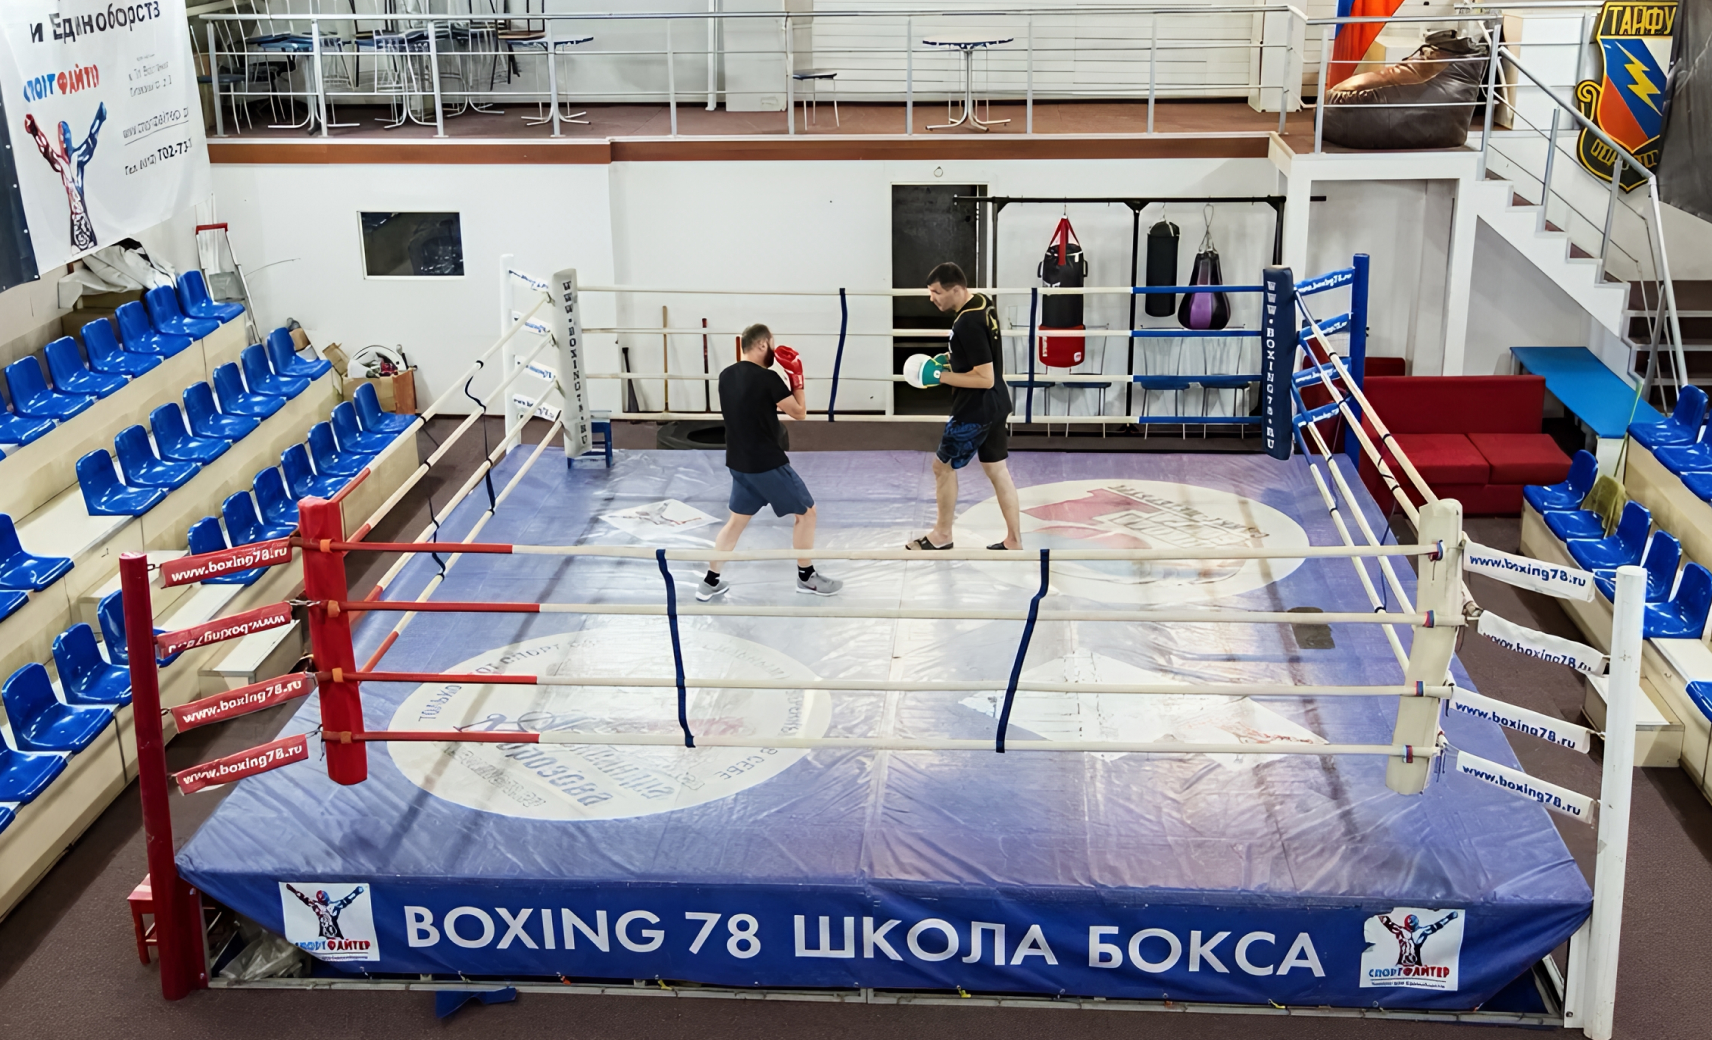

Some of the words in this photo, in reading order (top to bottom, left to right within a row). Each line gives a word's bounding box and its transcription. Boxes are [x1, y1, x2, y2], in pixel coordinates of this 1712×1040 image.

[171, 547, 288, 582] www.boxing78.ru
[1469, 555, 1586, 587] www.boxing78.ru
[183, 680, 302, 724] www.boxing78.ru
[1455, 702, 1576, 750] www.boxing78.ru
[182, 744, 303, 785] www.boxing78.ru
[1462, 765, 1581, 816] www.boxing78.ru
[404, 905, 665, 953] BOXING
[684, 911, 762, 959] 78
[793, 914, 1060, 967] ШКОЛА
[1087, 924, 1326, 978] БОКСА
